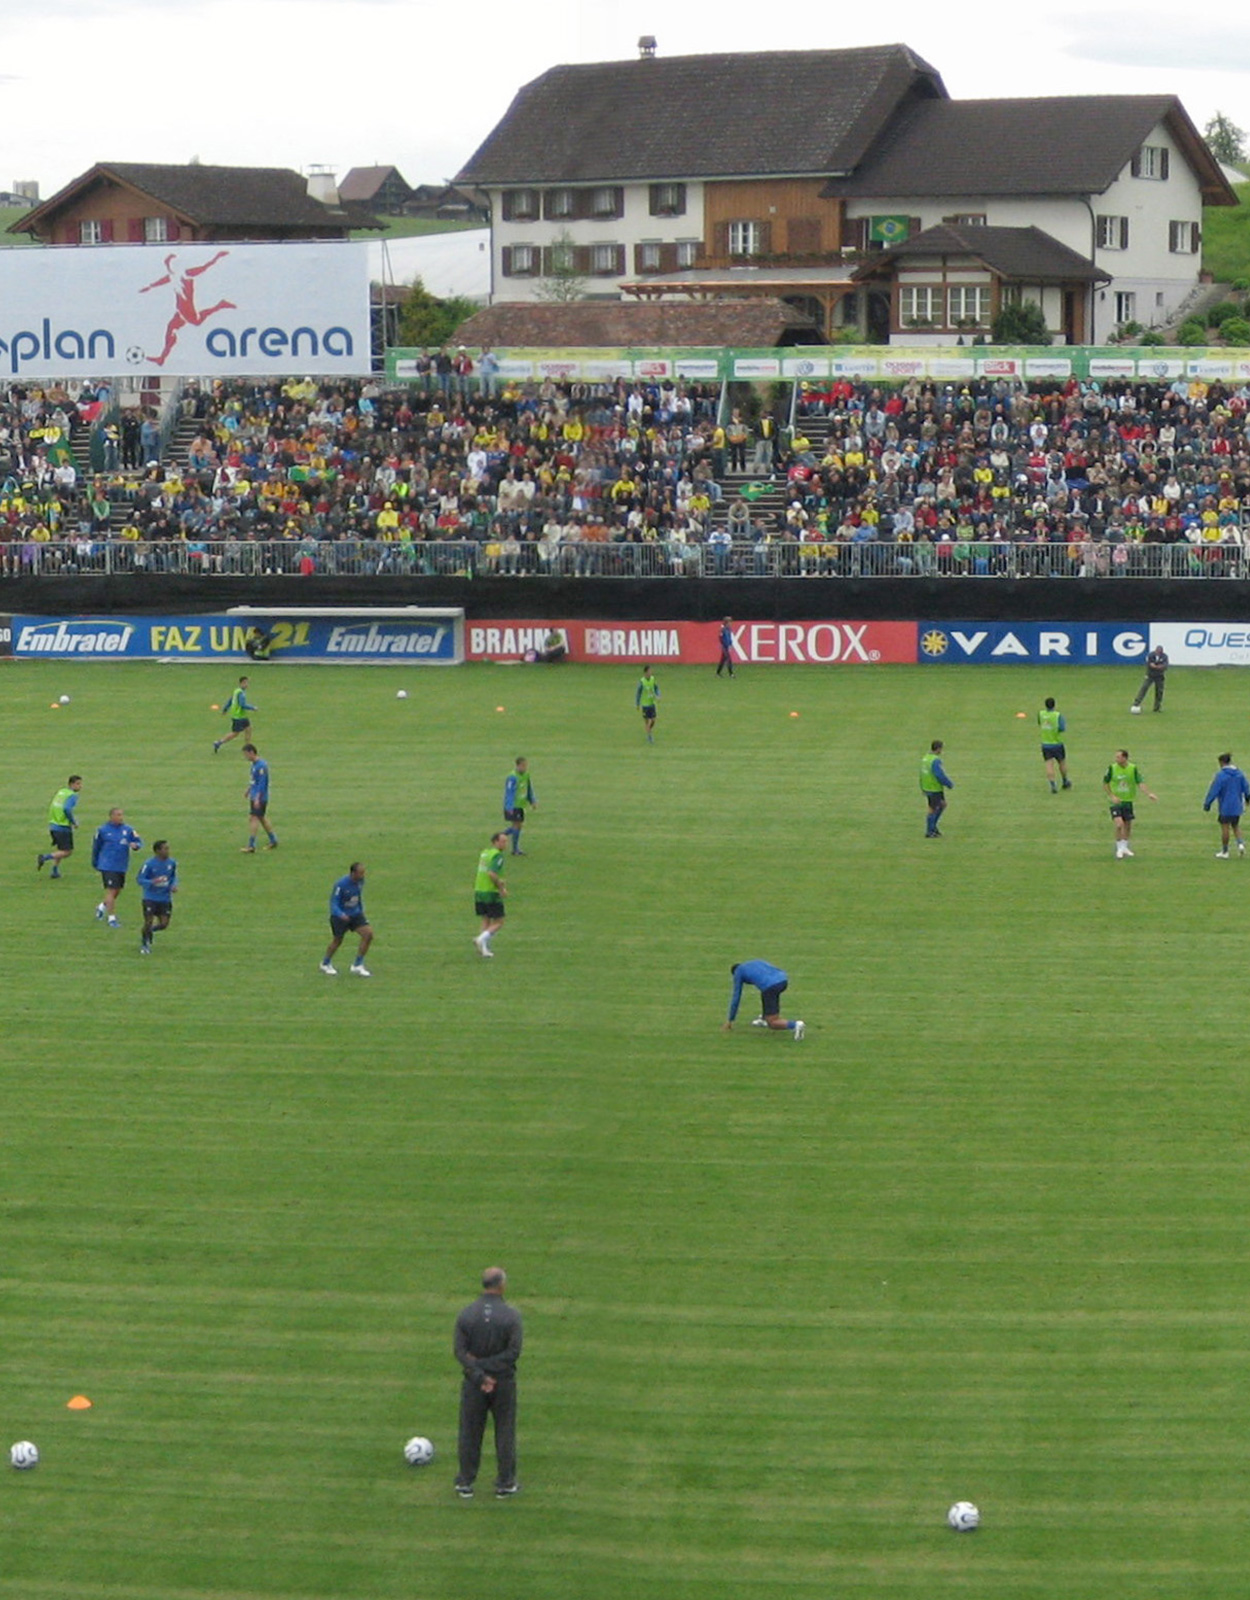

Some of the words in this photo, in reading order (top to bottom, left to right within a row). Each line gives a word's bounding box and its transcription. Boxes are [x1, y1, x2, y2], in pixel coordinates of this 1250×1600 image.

[206, 326, 353, 357] arena
[16, 621, 134, 651] Embratel
[151, 626, 202, 651] FAZ
[270, 622, 310, 650] 21
[326, 621, 448, 652] Embratel
[950, 631, 1149, 656] VARIG
